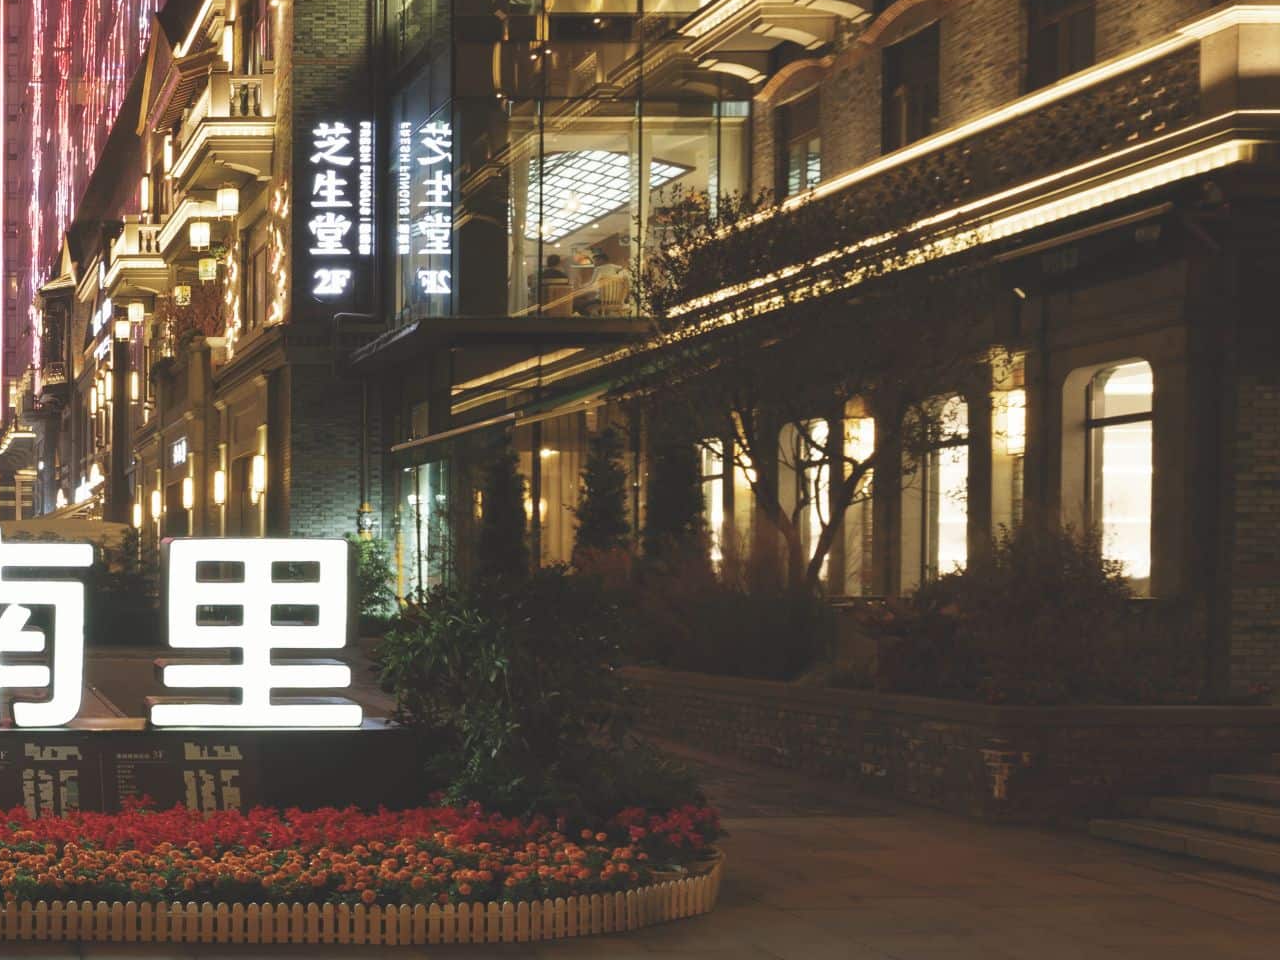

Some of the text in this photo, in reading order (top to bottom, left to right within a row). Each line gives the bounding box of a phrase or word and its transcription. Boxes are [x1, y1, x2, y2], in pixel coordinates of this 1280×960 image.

[359, 121, 372, 163] FRESH
[308, 121, 354, 255] 芝生堂
[312, 268, 352, 295] 2F
